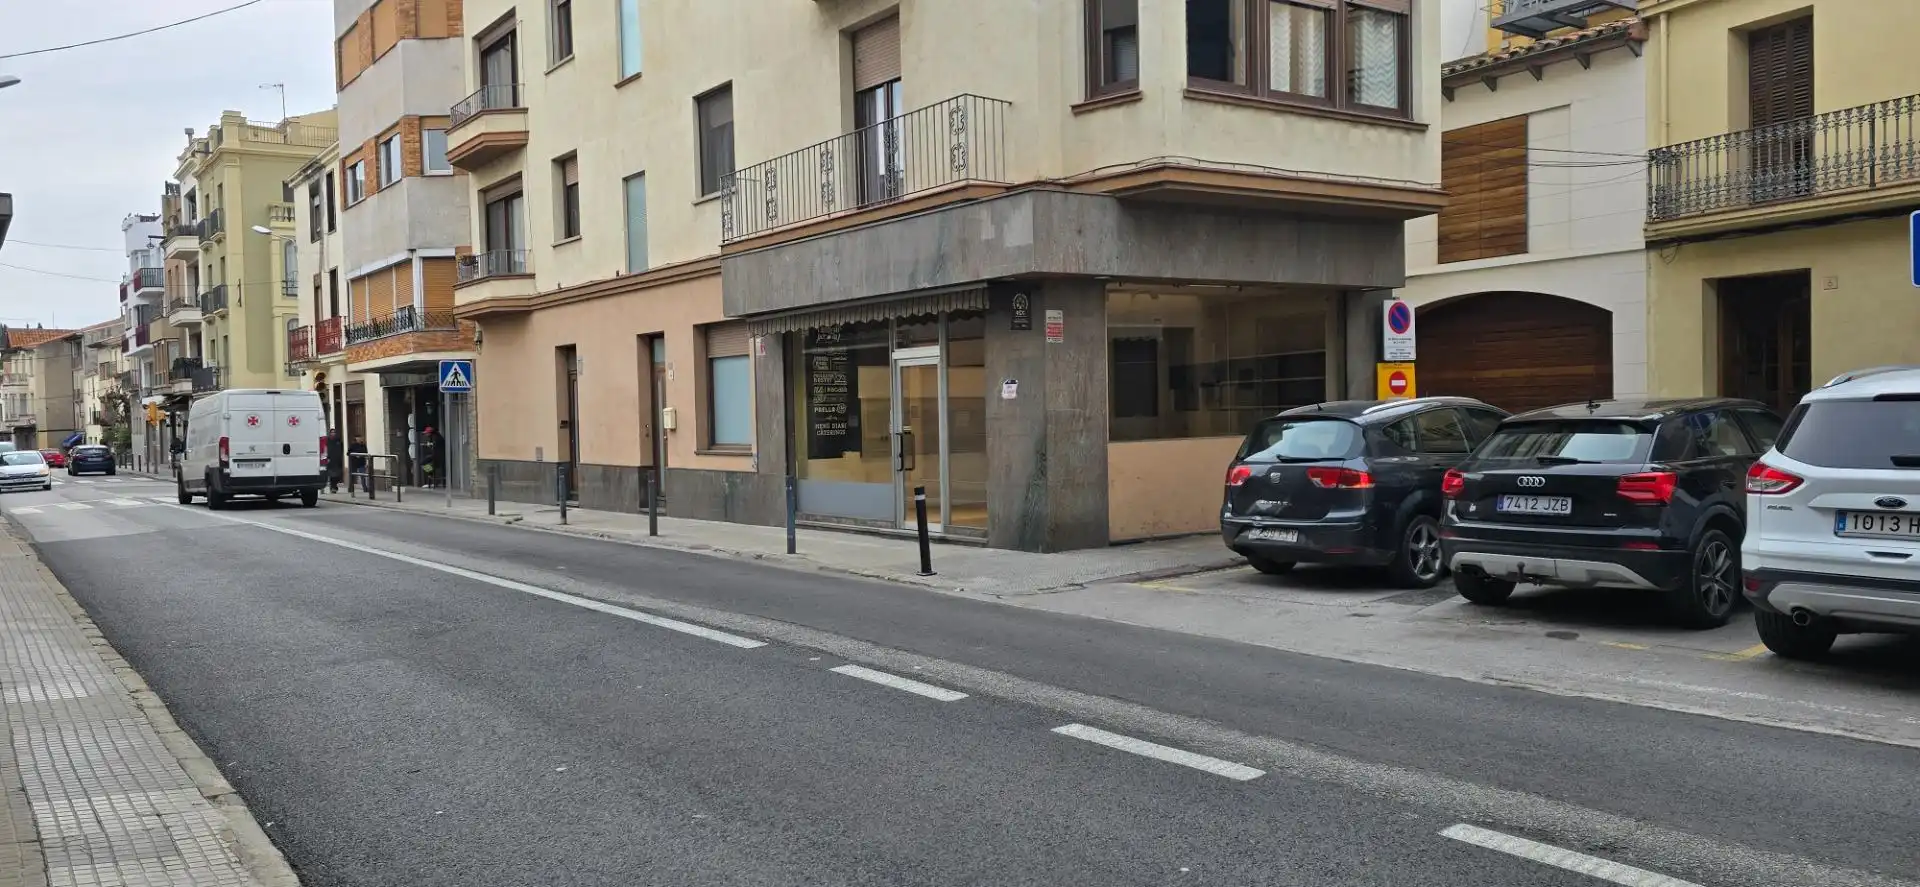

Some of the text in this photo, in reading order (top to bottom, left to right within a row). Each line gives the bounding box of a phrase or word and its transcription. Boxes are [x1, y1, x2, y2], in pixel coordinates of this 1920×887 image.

[1506, 496, 1569, 512] 7412 JZB
[1852, 513, 1920, 534] 1013 H
